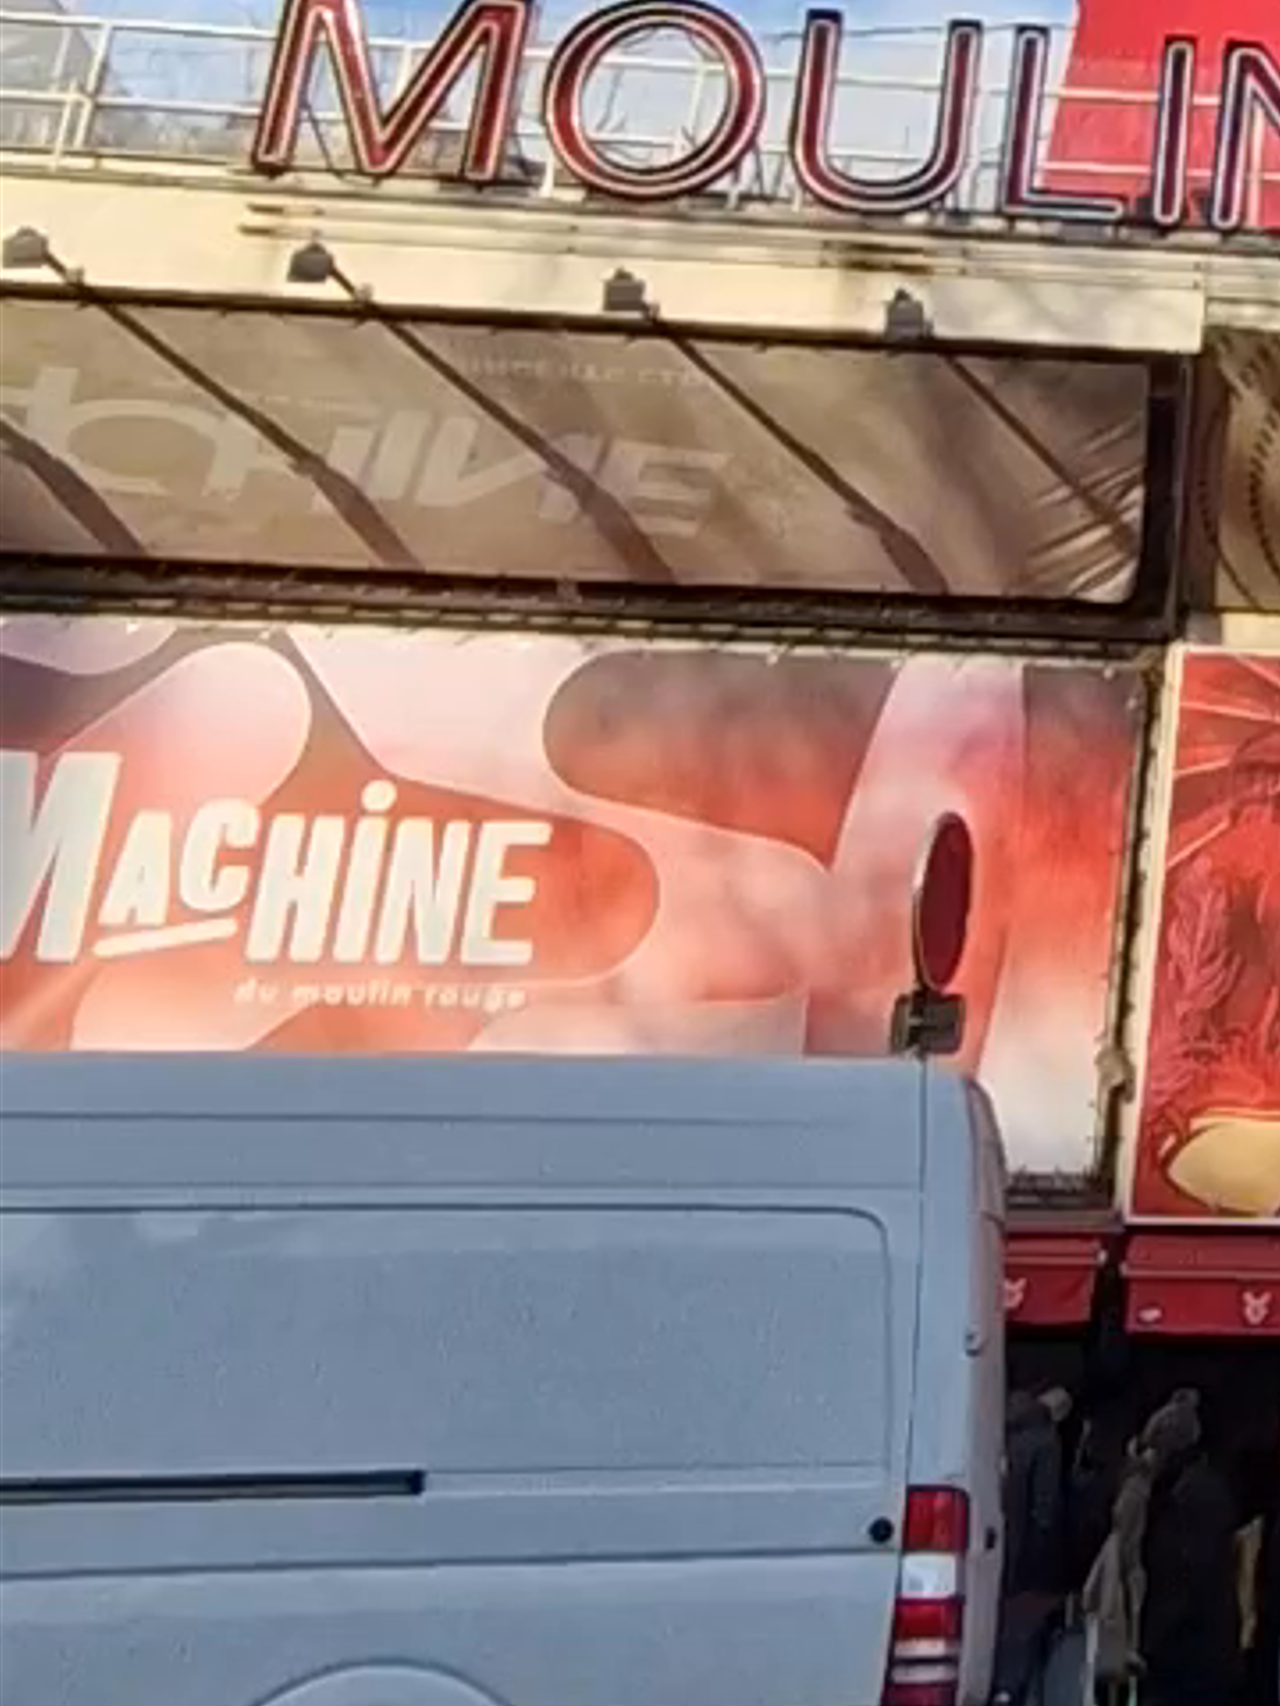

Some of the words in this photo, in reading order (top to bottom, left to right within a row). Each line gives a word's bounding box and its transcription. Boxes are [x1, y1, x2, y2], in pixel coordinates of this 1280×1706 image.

[234, 978, 281, 1004] du
[292, 979, 413, 1006] moulin
[424, 982, 526, 1012] rouge
